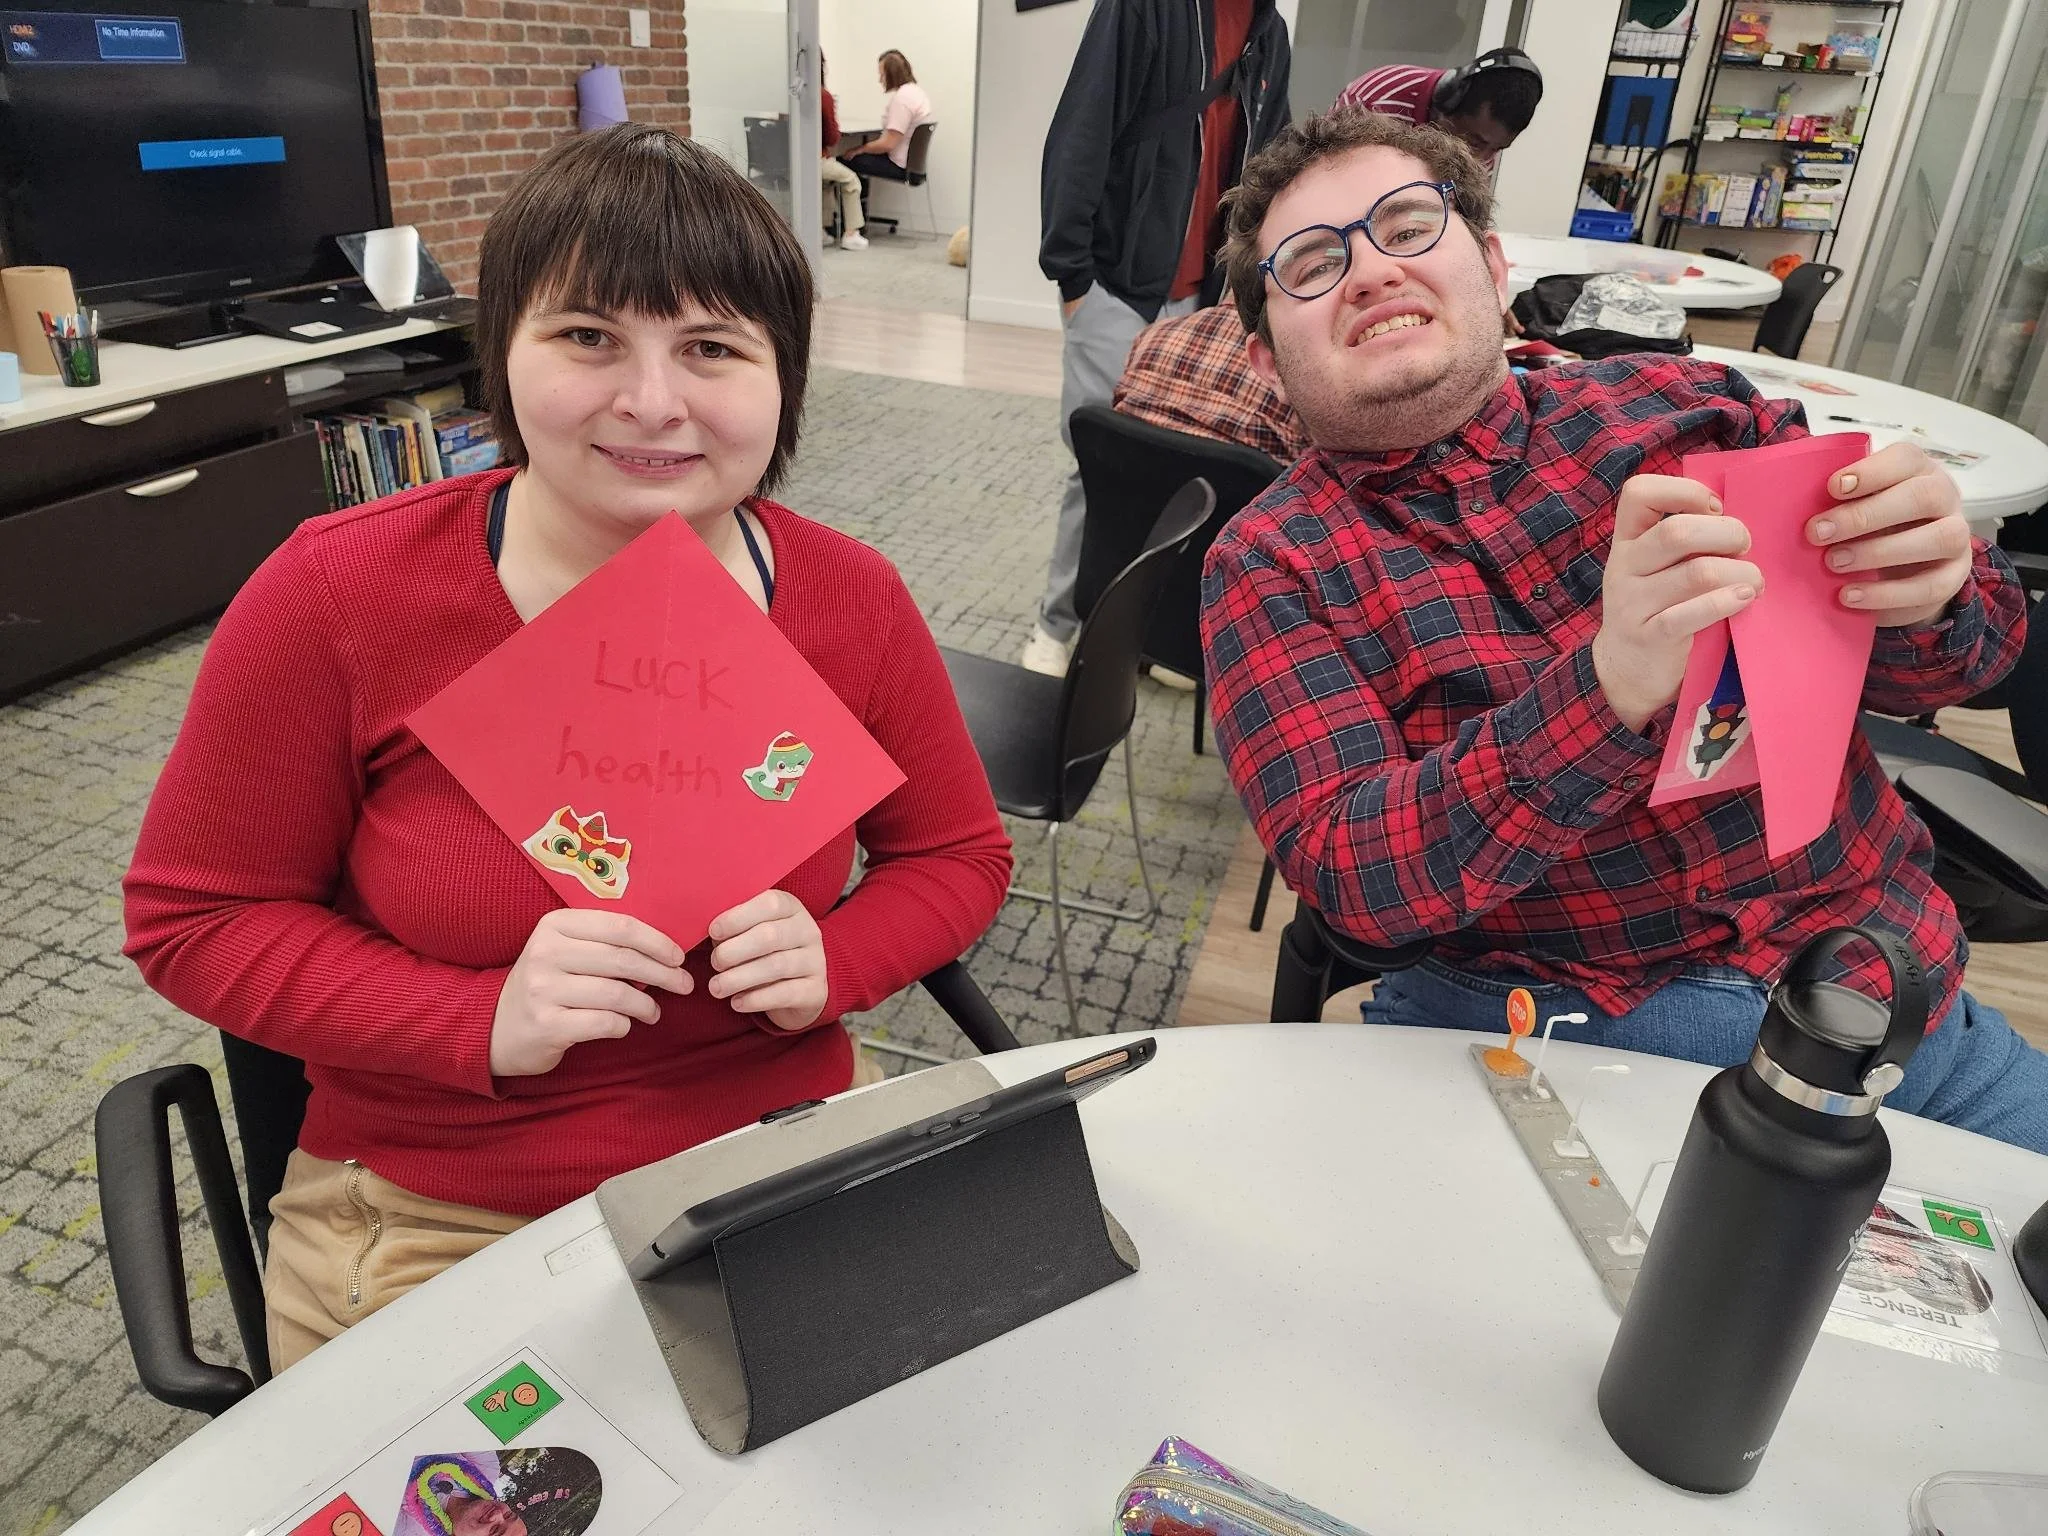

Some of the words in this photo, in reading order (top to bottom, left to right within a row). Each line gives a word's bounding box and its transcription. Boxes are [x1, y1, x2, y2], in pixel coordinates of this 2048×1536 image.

[102, 26, 111, 36] No
[113, 26, 128, 37] Time
[130, 27, 165, 37] Information
[12, 41, 30, 52] DVD
[555, 725, 723, 799] health
[1511, 999, 1527, 1024] STOP
[1858, 1292, 1963, 1329] TERENCE
